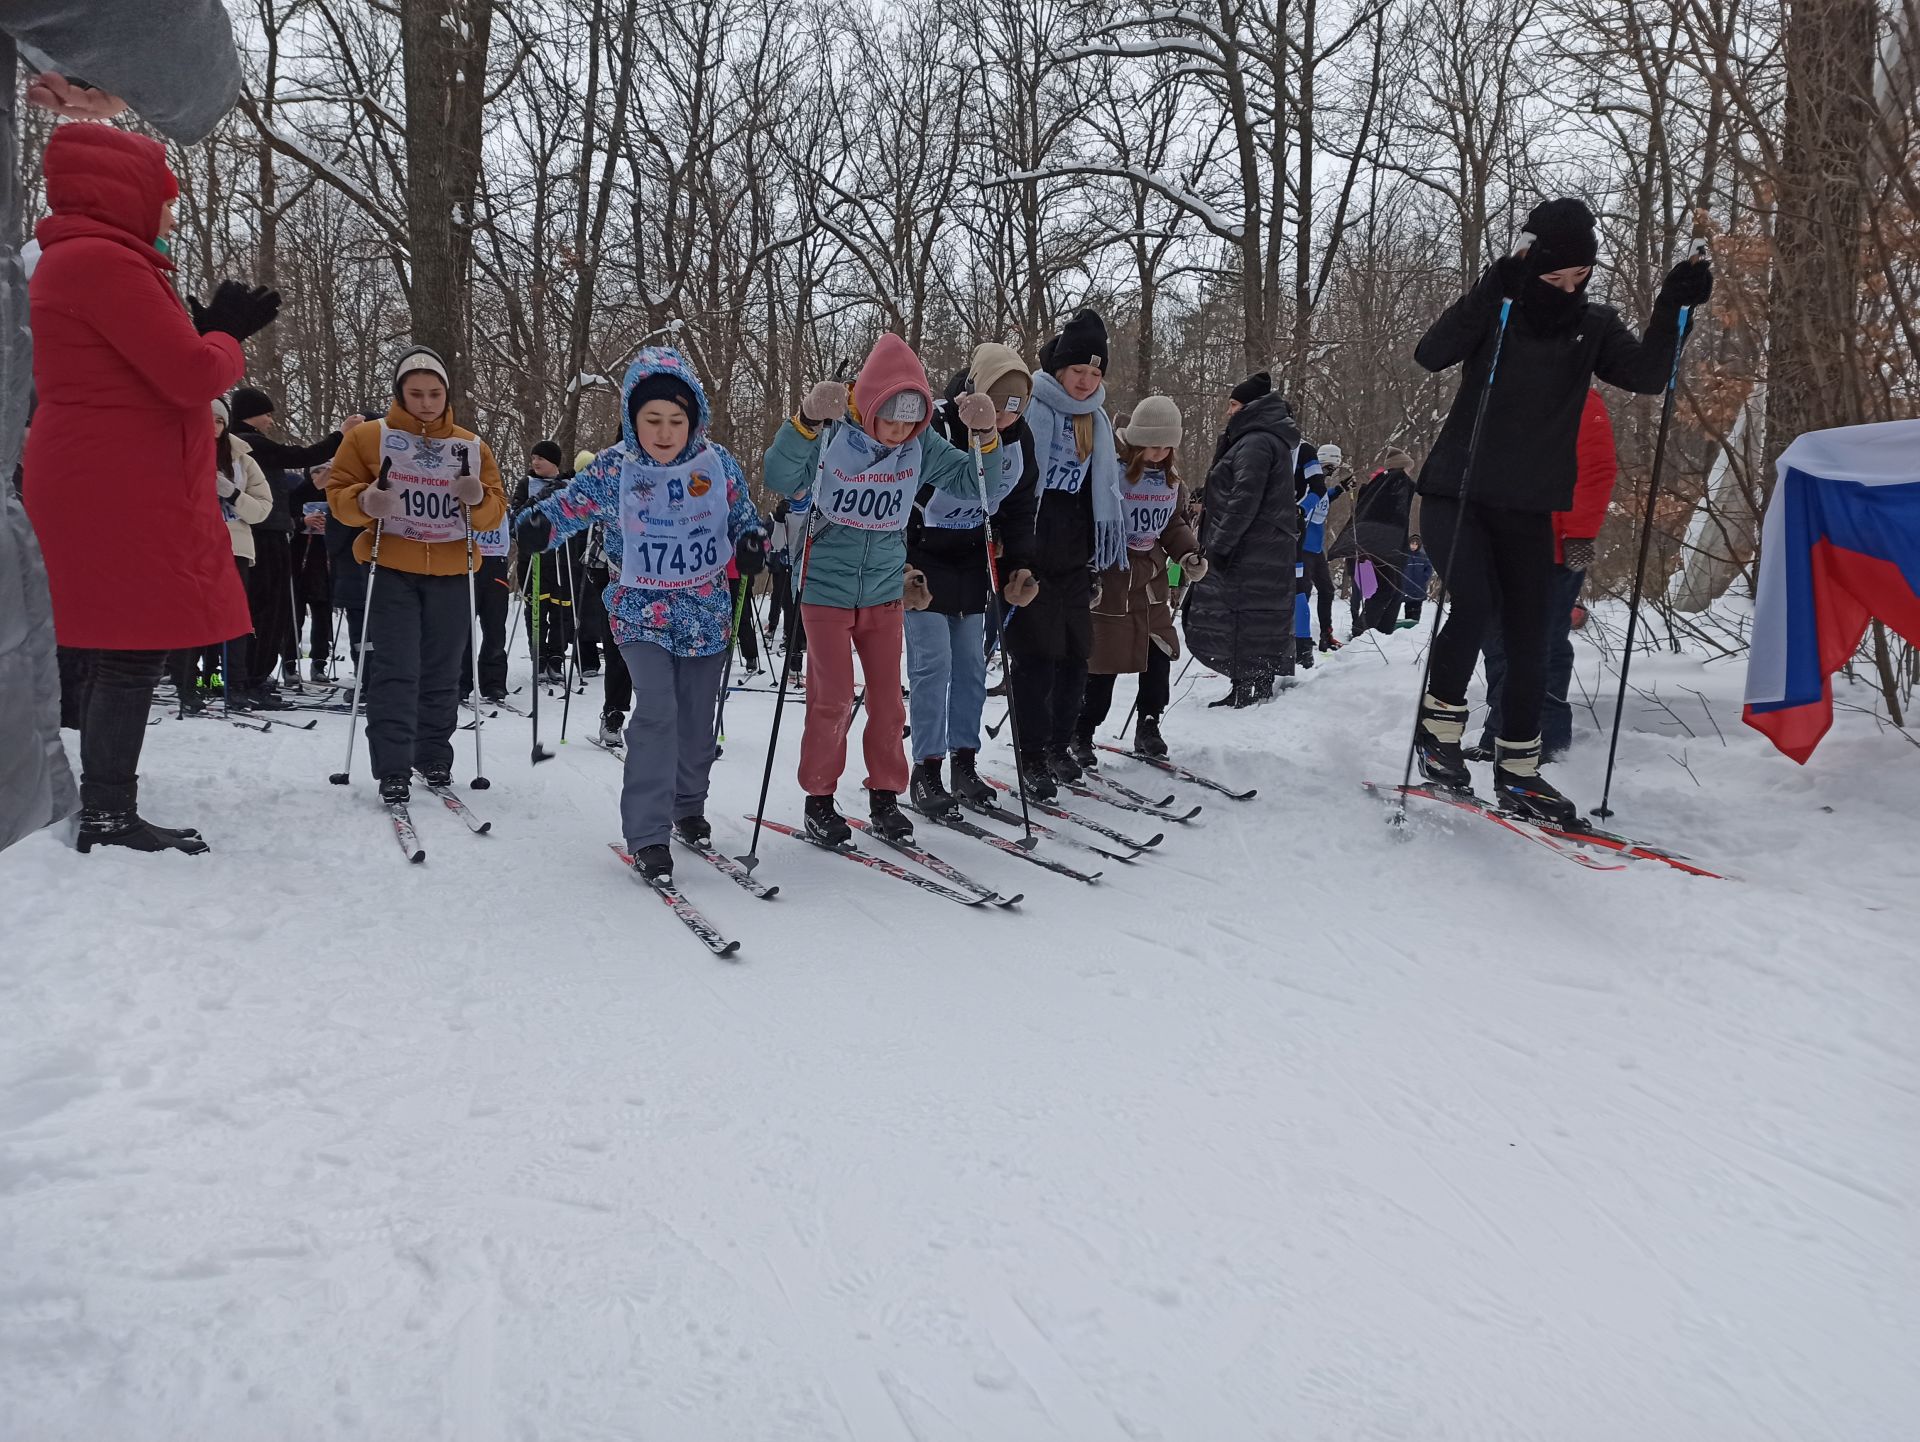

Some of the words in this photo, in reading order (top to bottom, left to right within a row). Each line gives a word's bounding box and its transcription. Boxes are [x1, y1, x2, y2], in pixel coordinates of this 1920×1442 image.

[388, 470, 419, 485] ЛЫЖНЯ
[421, 476, 449, 487] РОССИИ
[400, 488, 461, 519] 19002
[832, 488, 903, 521] 19008
[1124, 492, 1149, 502] ЛЫЖНЯ
[690, 510, 712, 522] TOYOTA
[638, 537, 717, 575] 17436
[635, 575, 656, 586] XXV
[657, 579, 693, 588] ЛЫЖНЯ
[916, 780, 927, 800] NEXT
[1528, 817, 1565, 833] ROSSIGNOL
